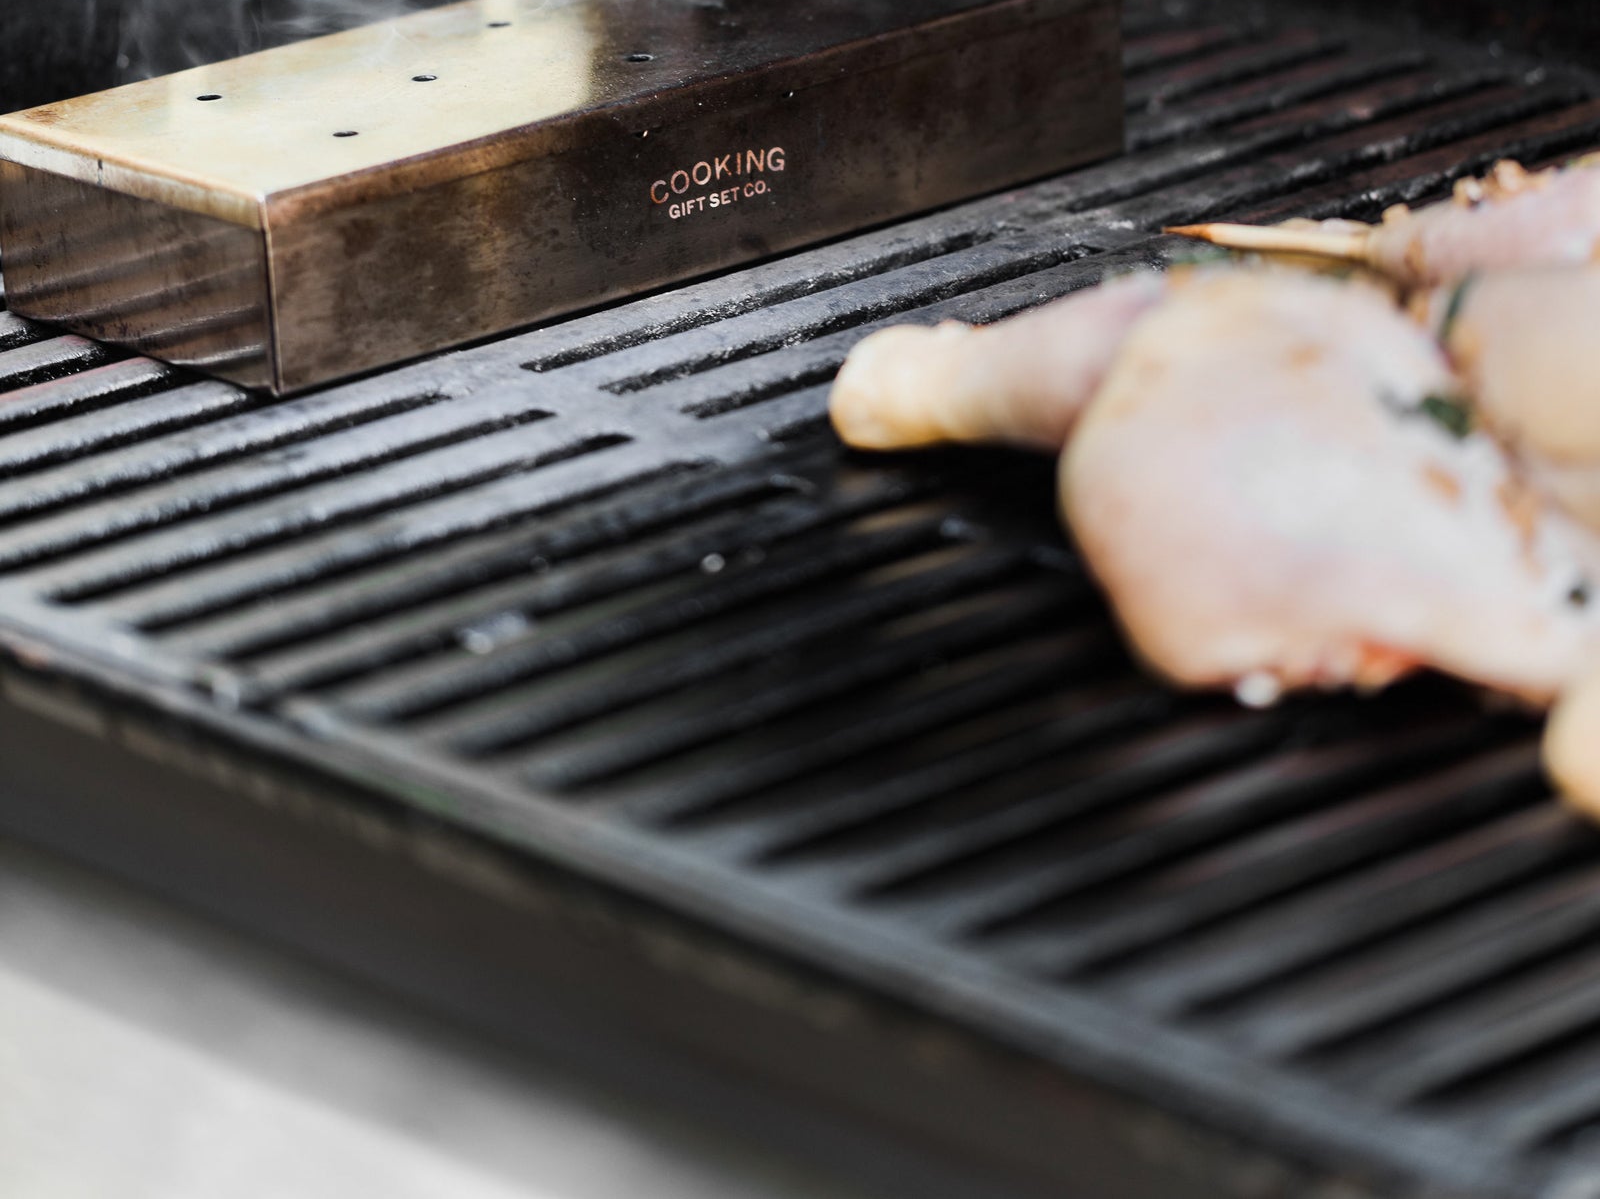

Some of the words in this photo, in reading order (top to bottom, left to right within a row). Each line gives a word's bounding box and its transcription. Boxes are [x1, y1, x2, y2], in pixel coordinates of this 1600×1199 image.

[650, 147, 786, 204] COOKING
[668, 197, 706, 219] GIFT
[709, 187, 740, 208] SET
[743, 180, 772, 198] CO.
